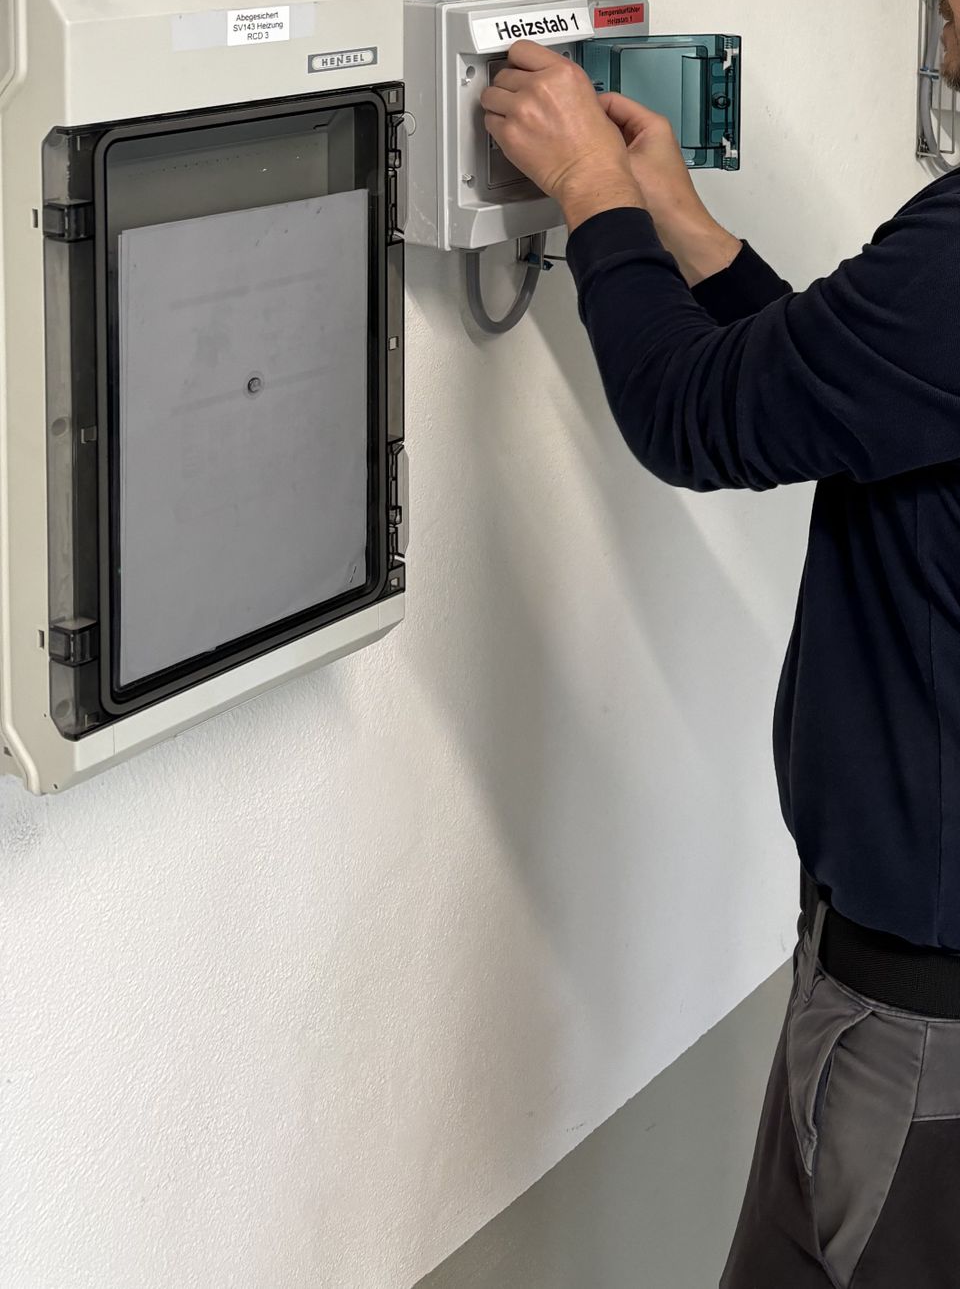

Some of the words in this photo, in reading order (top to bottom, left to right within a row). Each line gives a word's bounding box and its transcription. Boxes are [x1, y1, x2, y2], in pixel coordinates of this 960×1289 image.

[233, 23, 256, 32] SV143
[257, 21, 284, 30] Heizung
[495, 14, 569, 41] Heizstab
[570, 12, 579, 30] 1
[247, 31, 263, 40] RCD
[264, 31, 270, 39] 3
[321, 54, 365, 66] HENSEL
